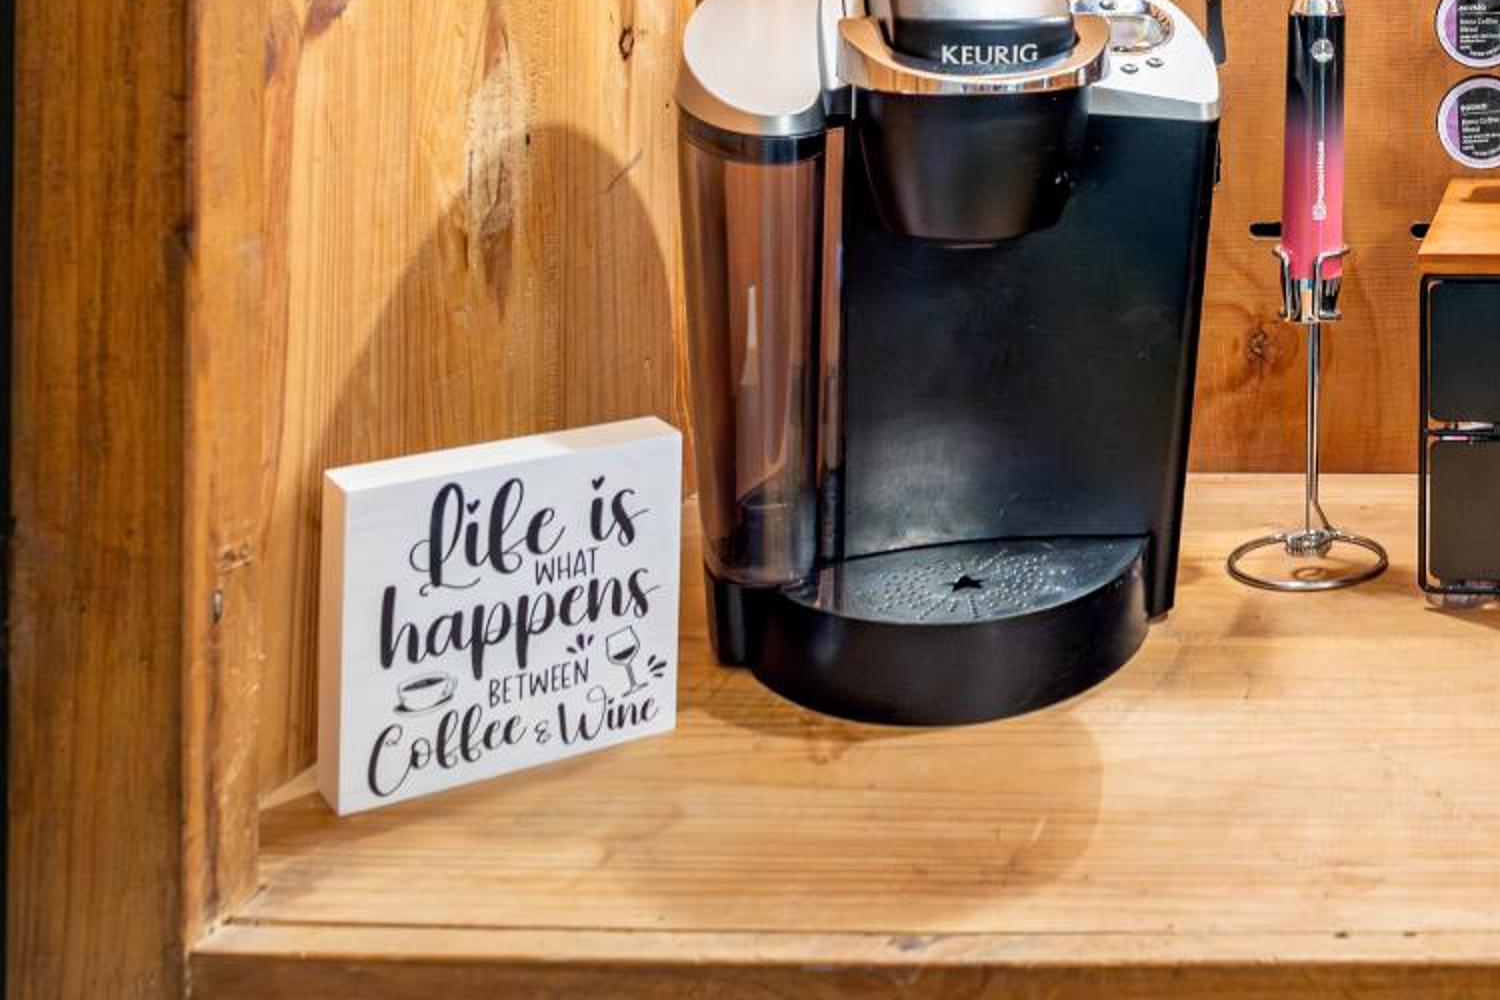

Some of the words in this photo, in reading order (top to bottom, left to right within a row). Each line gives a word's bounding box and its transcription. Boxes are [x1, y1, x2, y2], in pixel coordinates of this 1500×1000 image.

[941, 44, 1039, 66] KEURIG
[410, 477, 566, 597] Life
[590, 476, 650, 548] is
[534, 548, 598, 585] WHAT
[380, 567, 661, 681] happens
[489, 658, 590, 708] BETWEEN
[367, 703, 528, 797] Coffee
[534, 724, 553, 745] &
[558, 686, 660, 745] Wine
